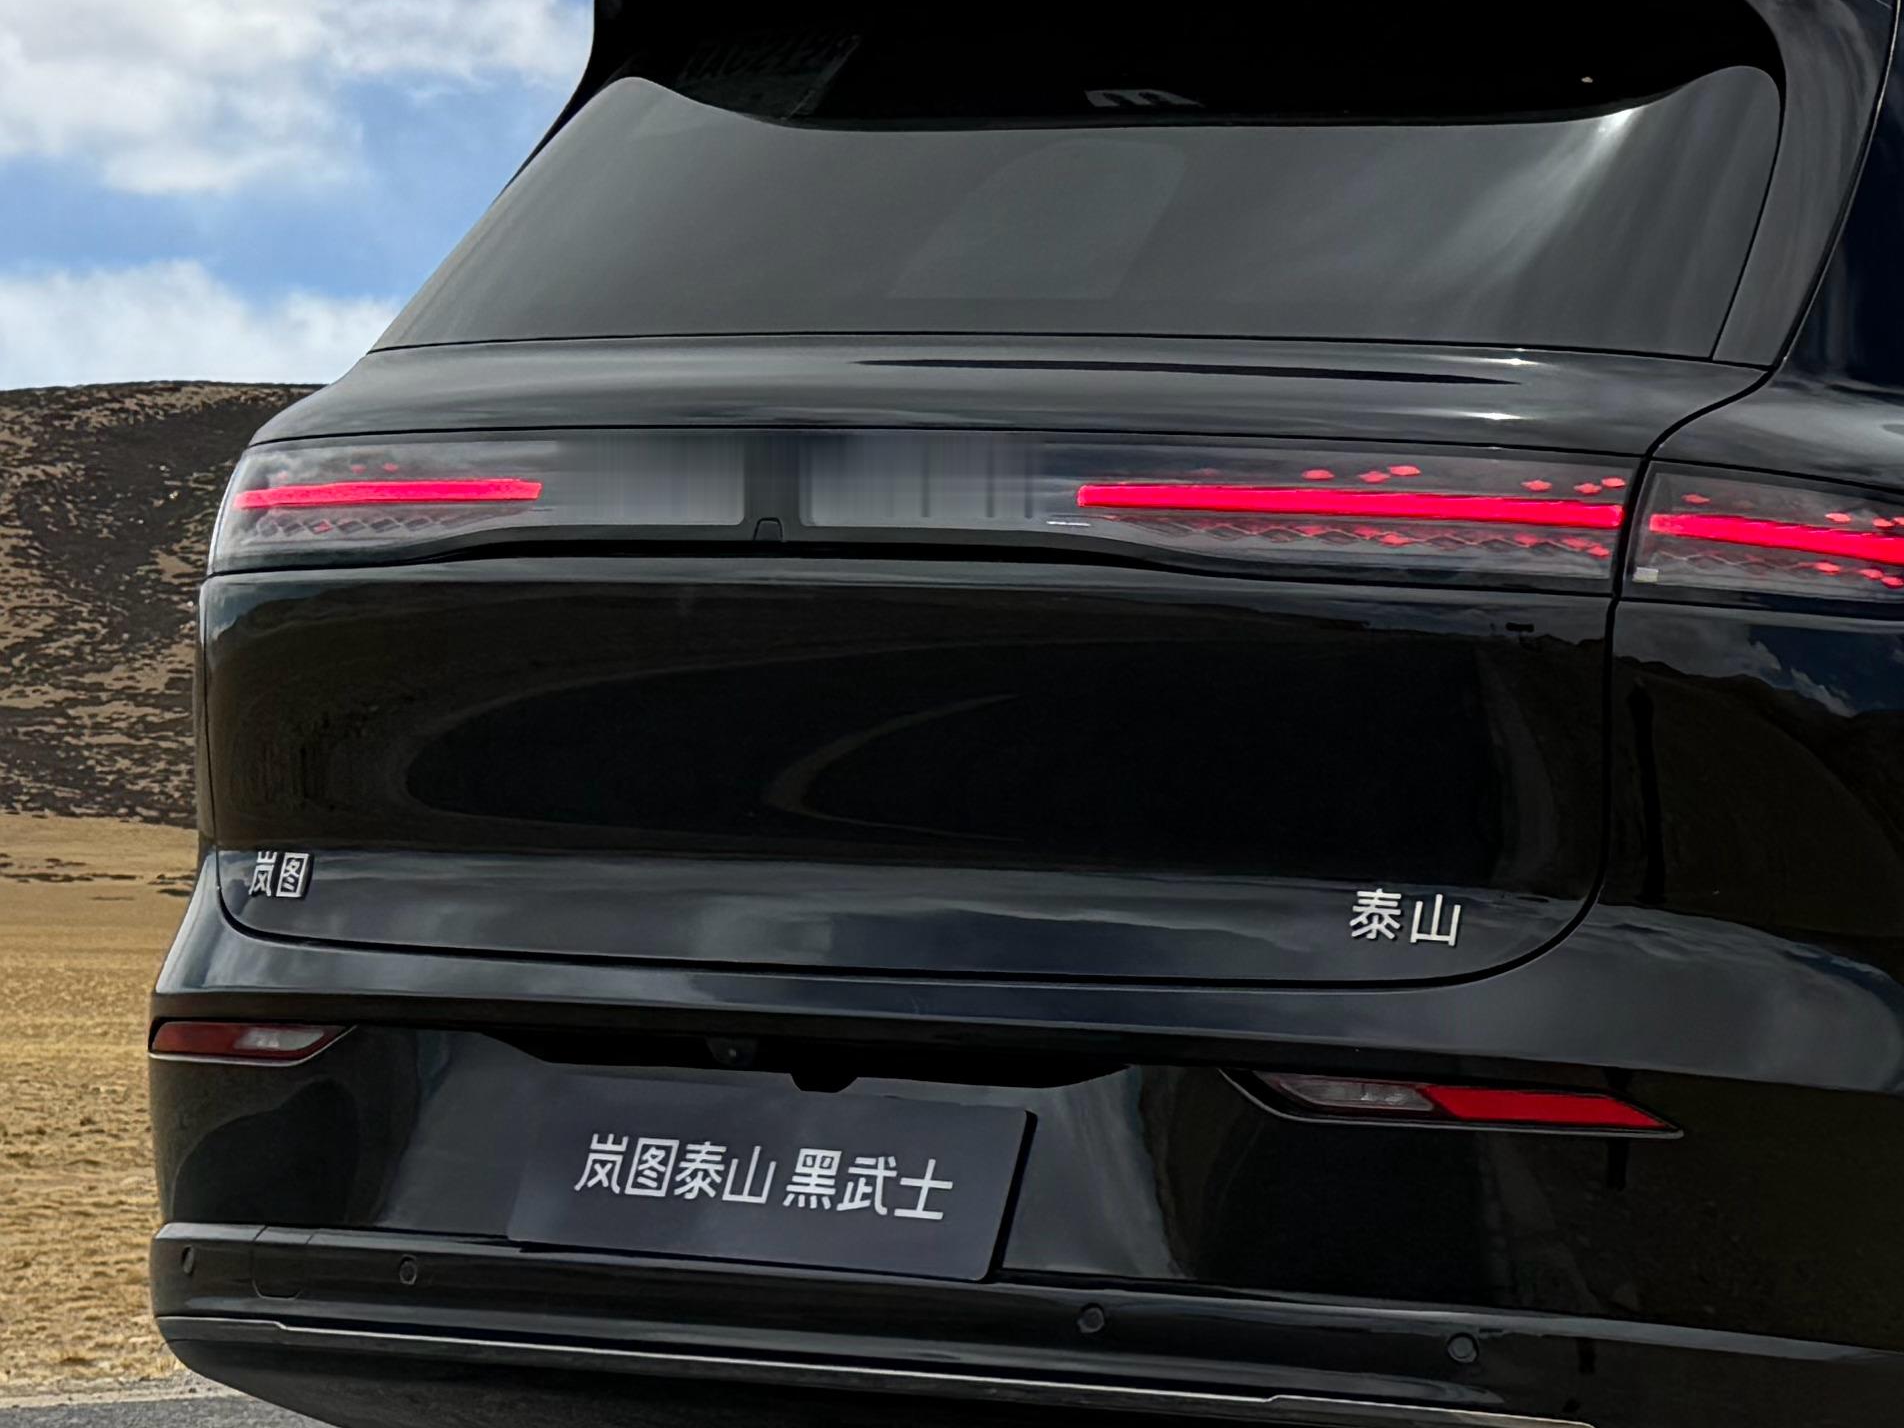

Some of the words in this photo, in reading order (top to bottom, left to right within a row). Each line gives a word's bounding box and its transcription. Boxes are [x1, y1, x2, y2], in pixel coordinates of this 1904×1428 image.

[248, 850, 310, 898] 岚图
[1349, 888, 1462, 947] 泰山
[573, 1132, 777, 1205] 岚图泰山
[782, 1147, 954, 1221] 黑武士
